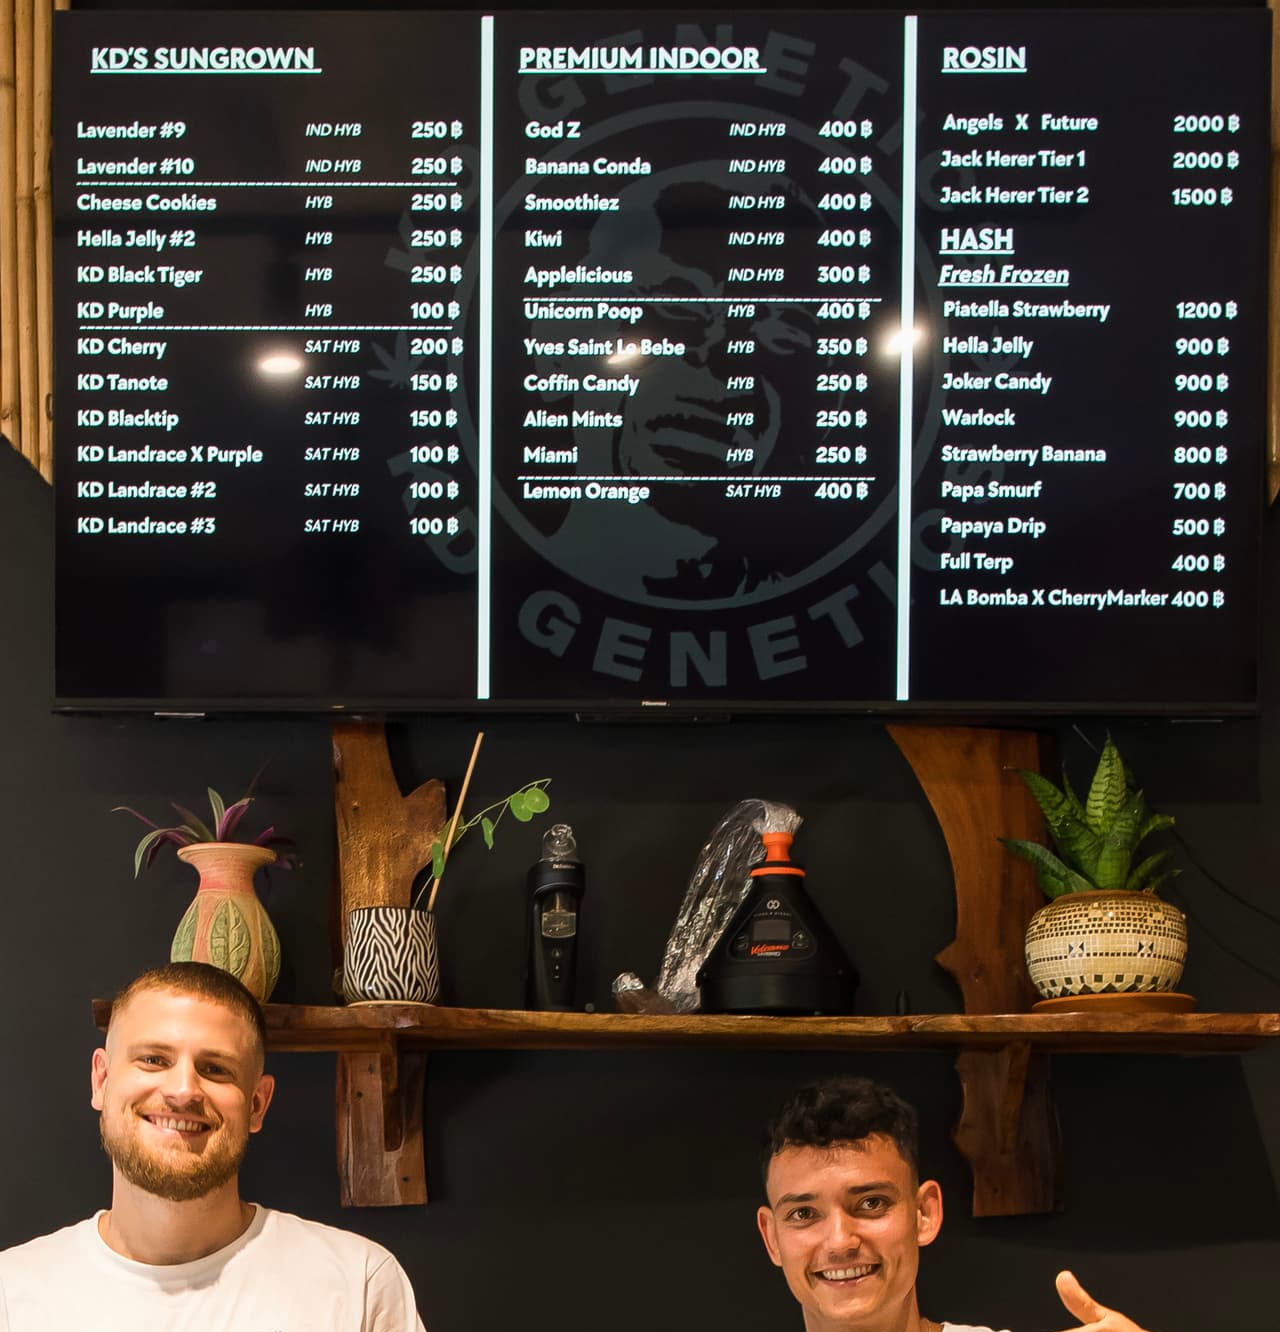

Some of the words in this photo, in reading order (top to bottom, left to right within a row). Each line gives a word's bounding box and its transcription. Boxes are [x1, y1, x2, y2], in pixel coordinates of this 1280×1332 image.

[91, 47, 148, 69] KD'S
[154, 47, 314, 69] SUNGROWN
[520, 47, 642, 69] PREMIUM
[649, 47, 760, 69] INDOOR
[942, 47, 1026, 69] ROSIN
[78, 121, 156, 138] Lavender
[160, 122, 185, 138] #9
[526, 121, 563, 138] God
[567, 122, 580, 138] Z
[943, 113, 1003, 135] Angels
[1016, 114, 1028, 130] X
[1042, 114, 1098, 130] Future
[78, 157, 156, 174] Lavender
[160, 158, 194, 174] #10
[526, 158, 589, 174] Banana
[593, 157, 651, 174] Conda
[941, 150, 982, 166] Jack
[986, 151, 1036, 166] Herer
[1038, 150, 1074, 166] Tier
[1077, 151, 1085, 166] 1
[77, 194, 142, 210] Cheese
[146, 194, 216, 210] Cookies
[525, 194, 619, 210] Smoothiez
[940, 186, 981, 203] Jack
[986, 187, 1035, 203] Herer
[1038, 187, 1073, 203] Tier
[1077, 187, 1088, 203] 2
[78, 230, 121, 246] Hella
[126, 230, 166, 251] Jelly
[169, 230, 195, 246] #2
[525, 230, 561, 246] Kiwi
[940, 228, 1014, 250] HASH
[78, 266, 104, 282] KD
[109, 266, 155, 282] Black
[157, 266, 203, 287] Tiger
[524, 266, 632, 287] Applelicious
[939, 264, 996, 284] Fresh
[1000, 264, 1070, 284] Frozen
[78, 302, 104, 318] KD
[109, 302, 163, 323] Purple
[525, 303, 593, 319] Unicorn
[598, 303, 643, 324] Poop
[944, 300, 1009, 317] Piatella
[1013, 300, 1110, 322] Strawberry
[78, 338, 104, 354] KD
[108, 338, 166, 359] Cherry
[524, 339, 564, 355] Yves
[568, 338, 613, 355] Saint
[617, 339, 636, 355] Le
[641, 339, 685, 356] Bebe
[944, 336, 988, 353] Hella
[992, 336, 1033, 358] Jelly
[78, 374, 104, 390] KD
[107, 374, 168, 390] Tanote
[524, 374, 579, 391] Coffin
[583, 374, 639, 396] Candy
[942, 372, 992, 389] Joker
[995, 373, 1051, 394] Candy
[78, 410, 104, 426] KD
[108, 409, 178, 431] Blacktip
[524, 410, 568, 427] Alien
[573, 411, 622, 427] Mints
[942, 409, 1015, 425] Warlock
[78, 446, 104, 461] KD
[109, 445, 187, 462] Landrace
[191, 446, 203, 462] X
[208, 446, 263, 467] Purple
[524, 447, 577, 463] Miami
[942, 445, 1038, 466] Strawberry
[1042, 446, 1106, 461] Banana
[78, 482, 104, 497] KD
[109, 481, 187, 497] Landrace
[191, 482, 216, 497] #2
[524, 484, 581, 498] Lemon
[585, 484, 649, 503] Orange
[942, 481, 984, 502] Papa
[988, 481, 1042, 497] Smurf
[78, 518, 103, 533] KD
[109, 517, 186, 533] Landrace
[190, 518, 215, 533] #3
[942, 517, 1003, 538] Papaya
[1008, 518, 1046, 538] Drip
[941, 552, 970, 569] Full
[974, 553, 1013, 574] Terp
[941, 589, 963, 604] LA
[968, 589, 1028, 605] Bomba
[1032, 590, 1044, 605] X
[1049, 589, 1168, 610] CherryMarker
